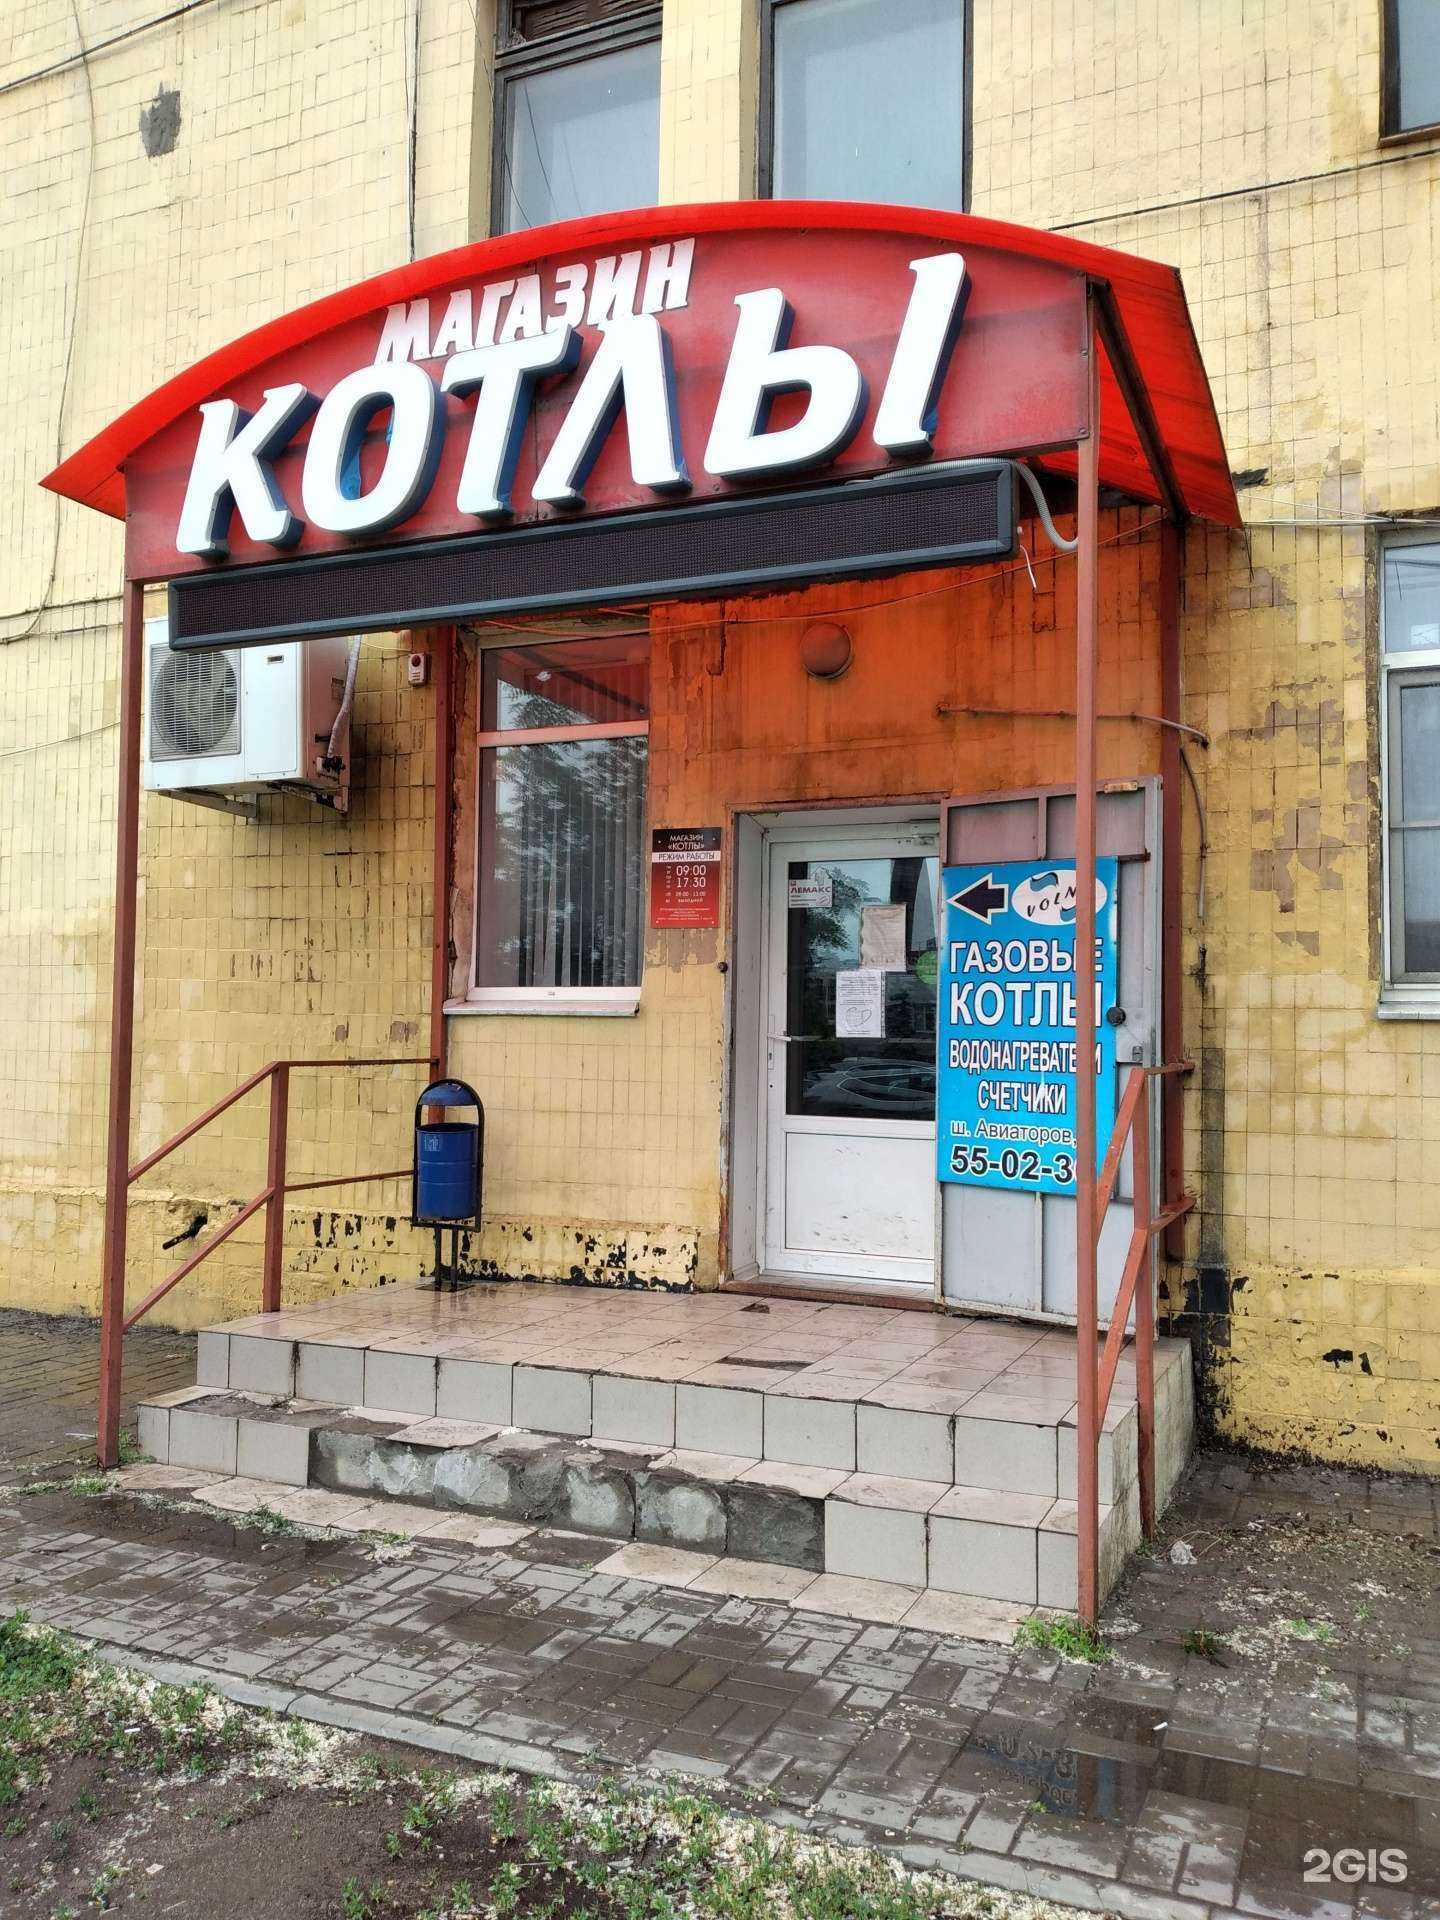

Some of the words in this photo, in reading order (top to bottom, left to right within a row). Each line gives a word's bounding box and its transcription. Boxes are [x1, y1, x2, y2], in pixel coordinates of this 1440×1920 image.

[375, 237, 696, 364] МАГАЗИН
[175, 252, 968, 557] КОТЛЫ
[658, 853, 684, 861] РЕЖИМ
[686, 852, 715, 860] РАБОТЫ
[1027, 886, 1076, 917] VOLN
[949, 1039, 1102, 1075] ВОДОНАГРЕВАТЕИ
[977, 1081, 1067, 1114] СЧЕТЧИКИ
[951, 1120, 971, 1136] ш.
[950, 1145, 1077, 1185] 55-02-3
